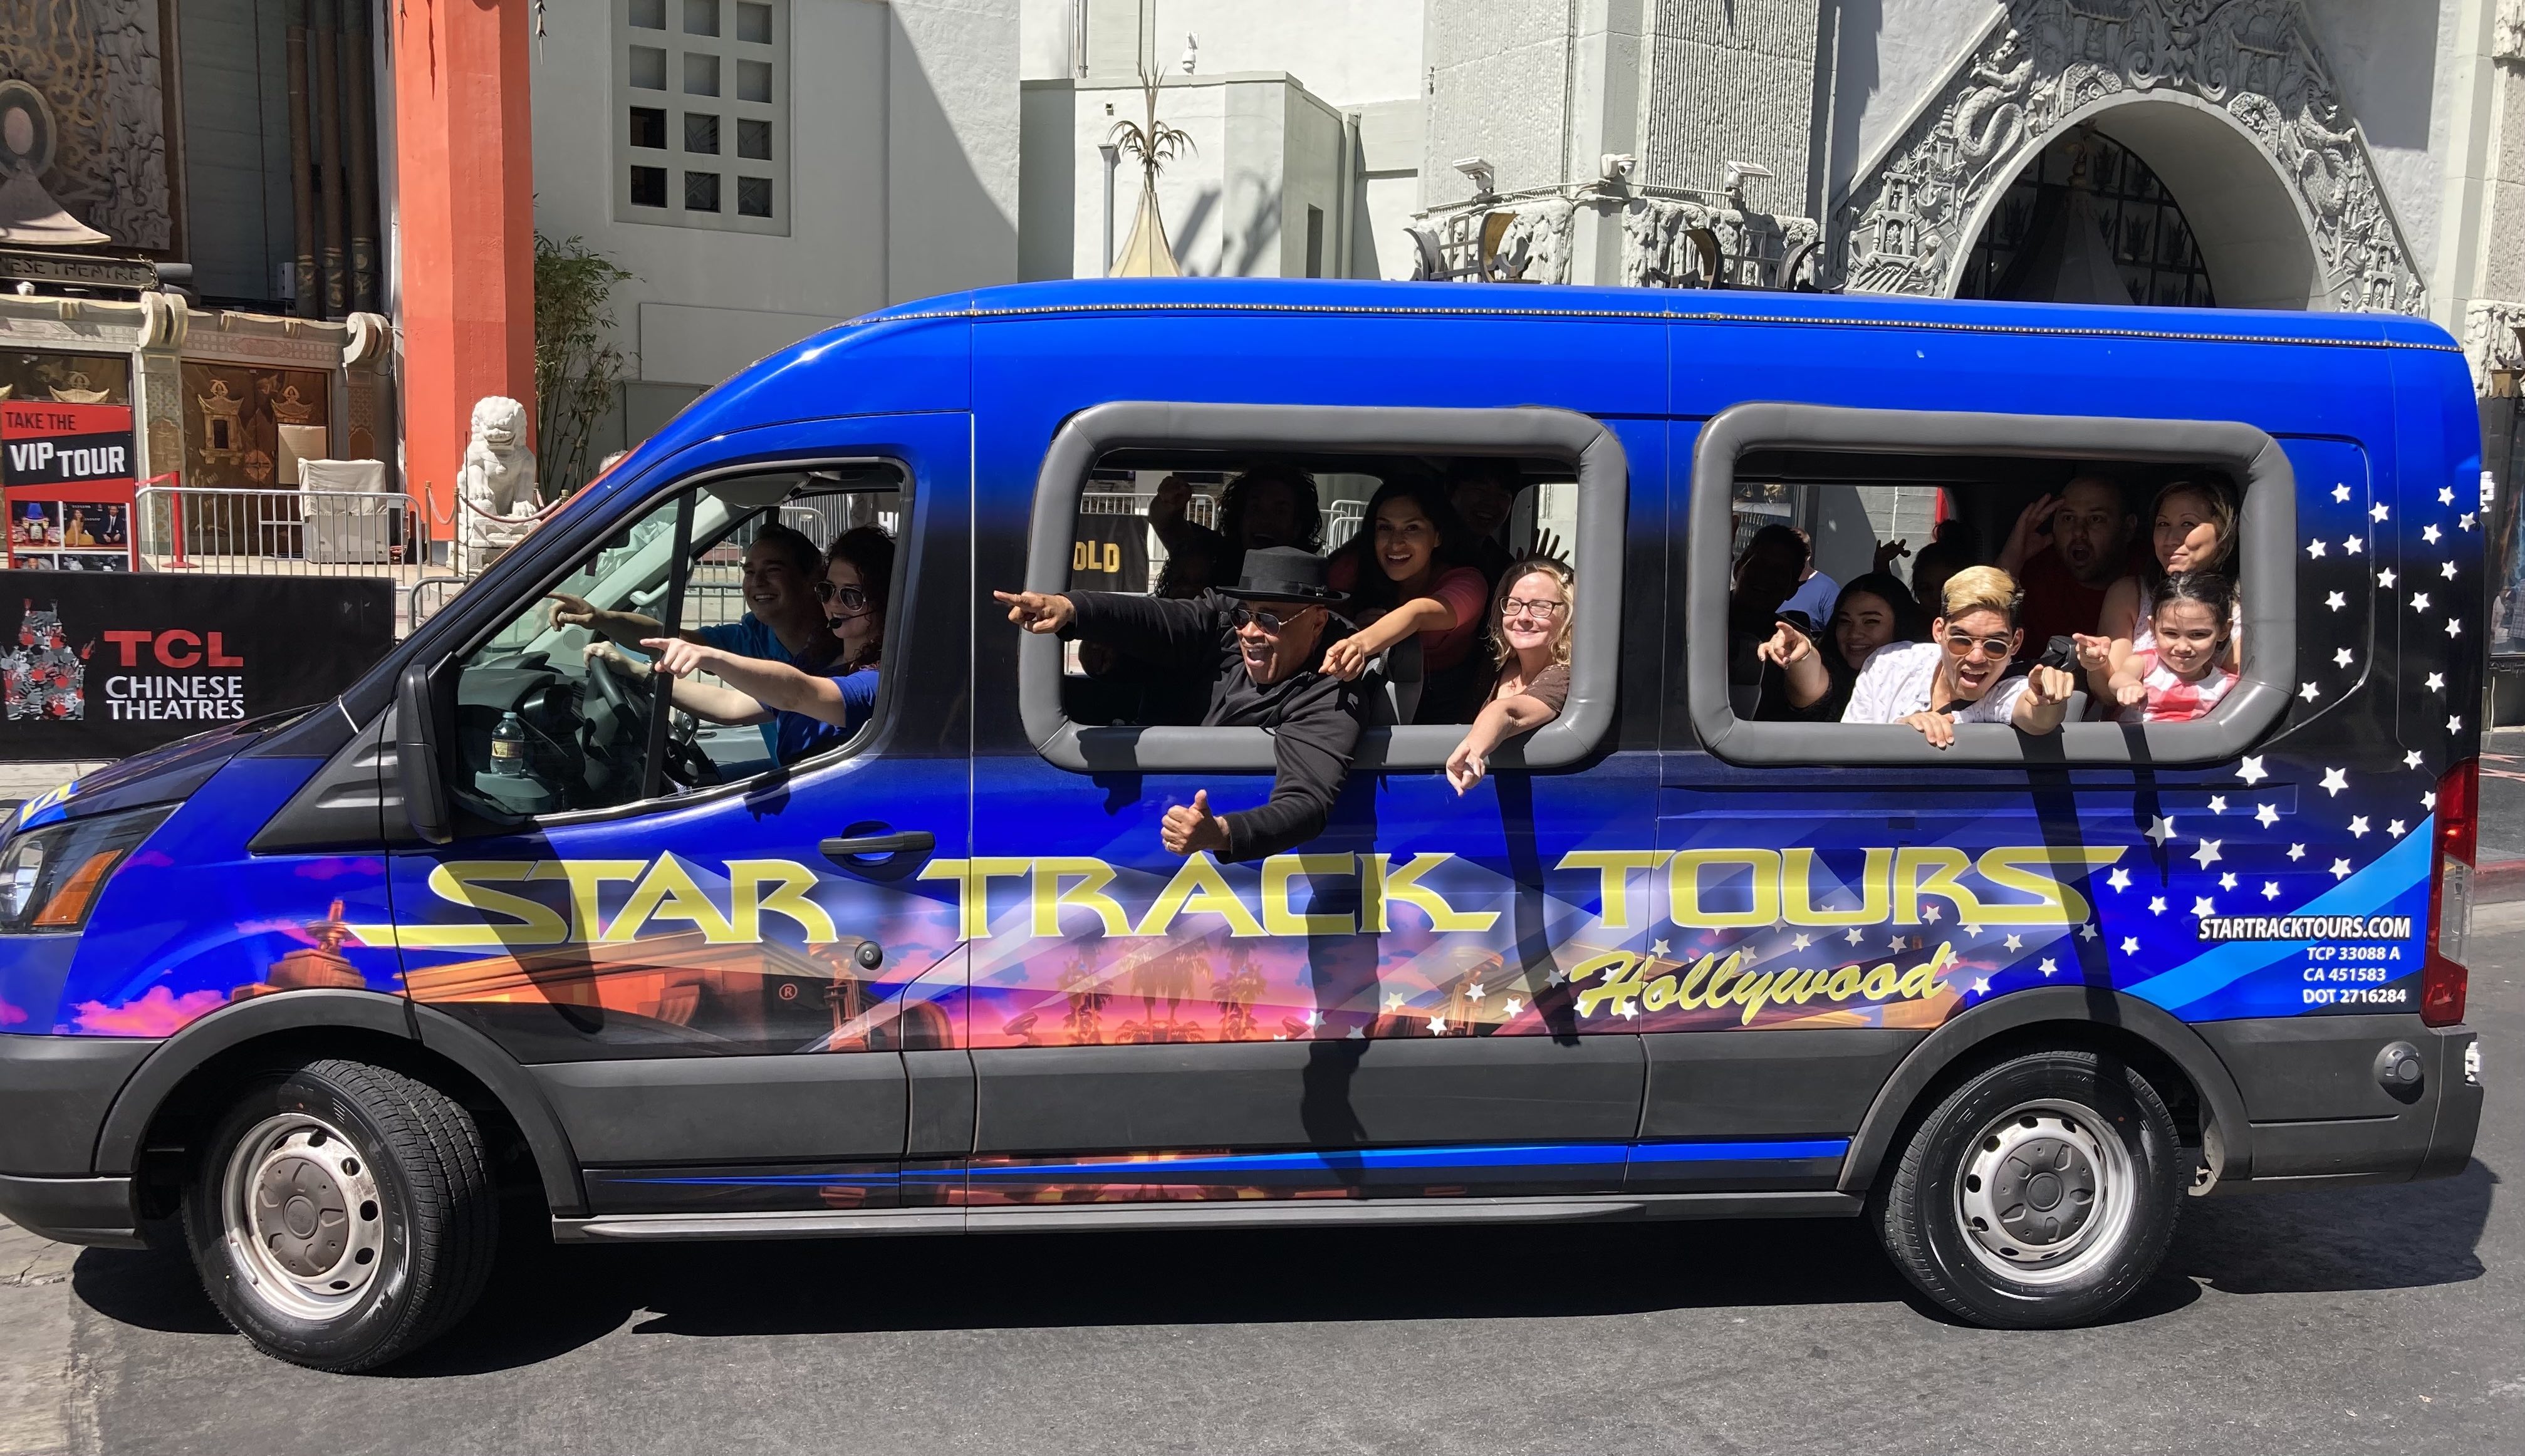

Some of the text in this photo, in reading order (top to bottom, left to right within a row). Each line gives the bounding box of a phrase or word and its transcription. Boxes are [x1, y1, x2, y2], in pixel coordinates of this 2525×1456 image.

[54, 260, 141, 281] THEATRE
[5, 412, 76, 431] TAKE THE
[9, 442, 125, 477] VIP TOUR
[103, 629, 244, 668] TCL
[105, 675, 244, 699] CHINESE
[106, 699, 245, 720] THEATRES
[346, 845, 2130, 947] STAR TRACK TOURS
[2199, 916, 2411, 939] STARTRACKTOURS.COM
[2306, 947, 2401, 960] TCP 33088 A
[1568, 940, 1949, 1026] Hollywood
[2303, 968, 2387, 982] CA 451583
[2303, 989, 2407, 1004] DOT 2716284
